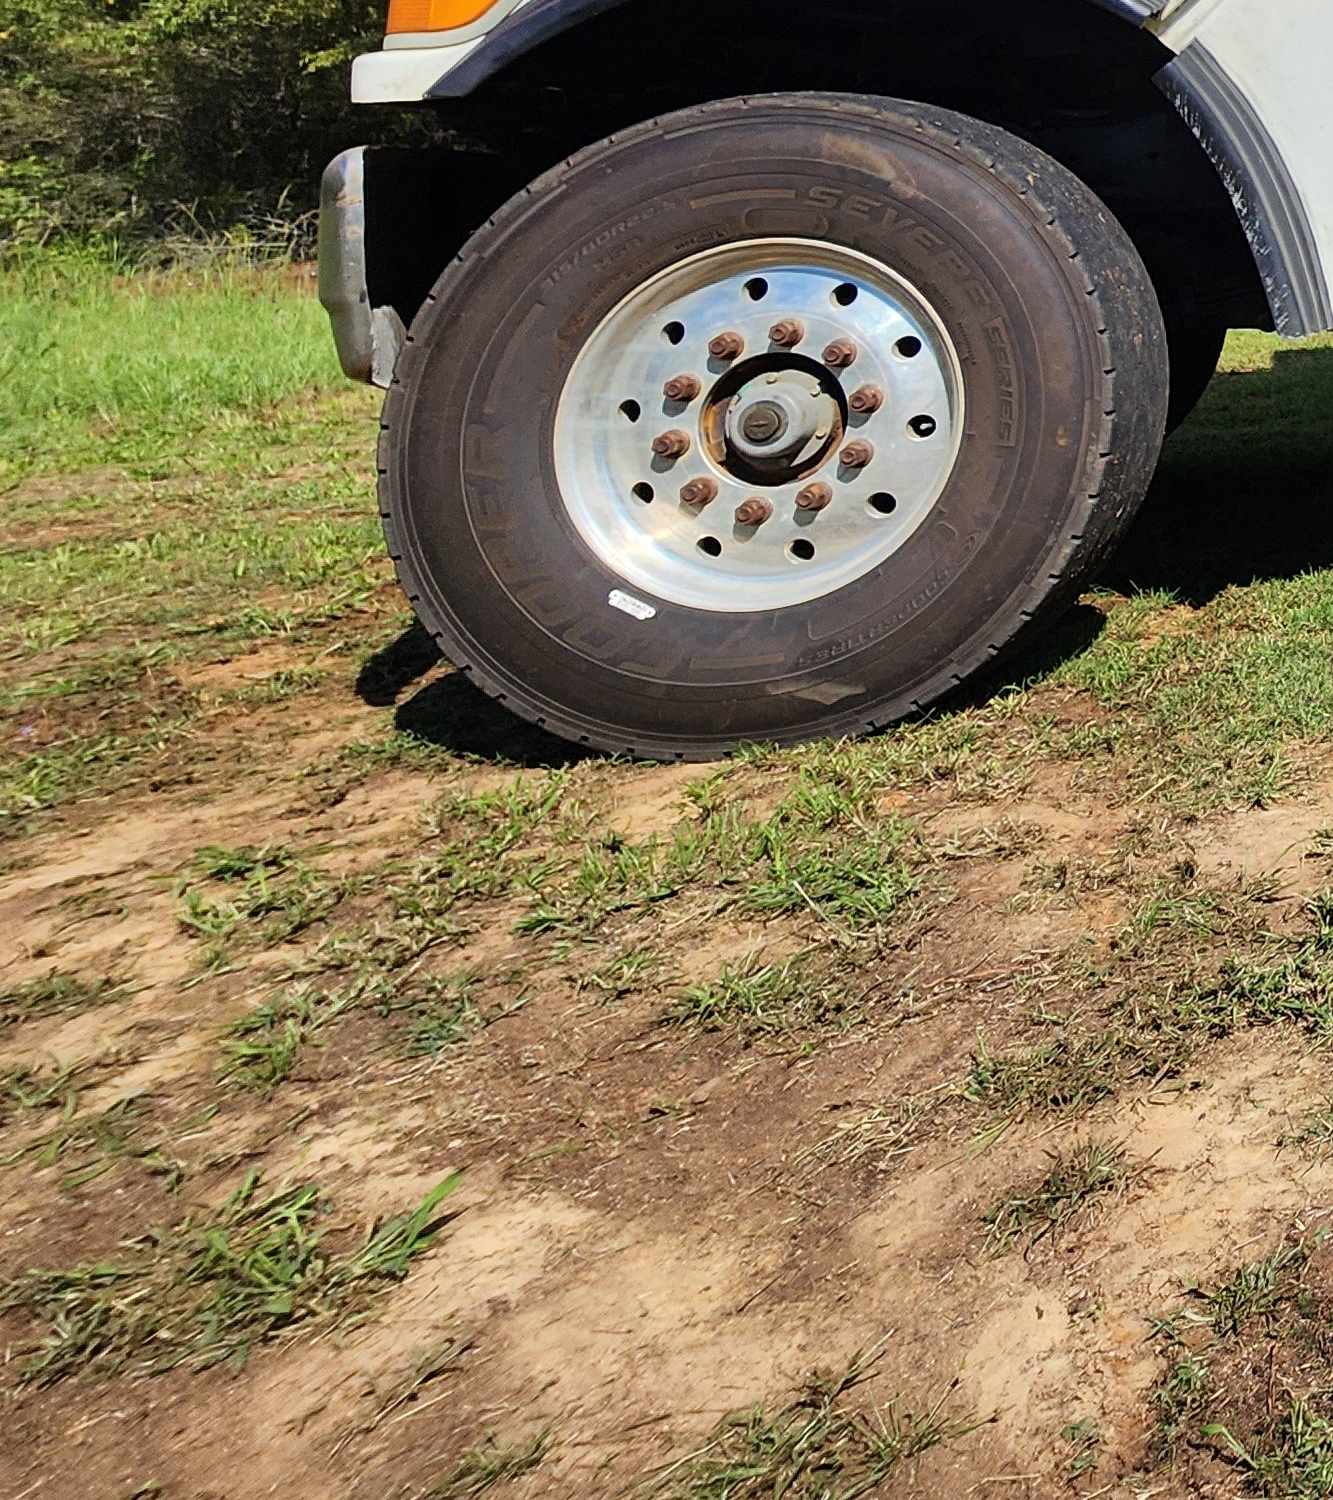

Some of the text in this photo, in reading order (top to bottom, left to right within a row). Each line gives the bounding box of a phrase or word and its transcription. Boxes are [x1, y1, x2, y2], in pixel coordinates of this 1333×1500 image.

[803, 185, 994, 308] SEVERE
[984, 320, 1016, 445] SERIES
[465, 422, 686, 678] COOPER
